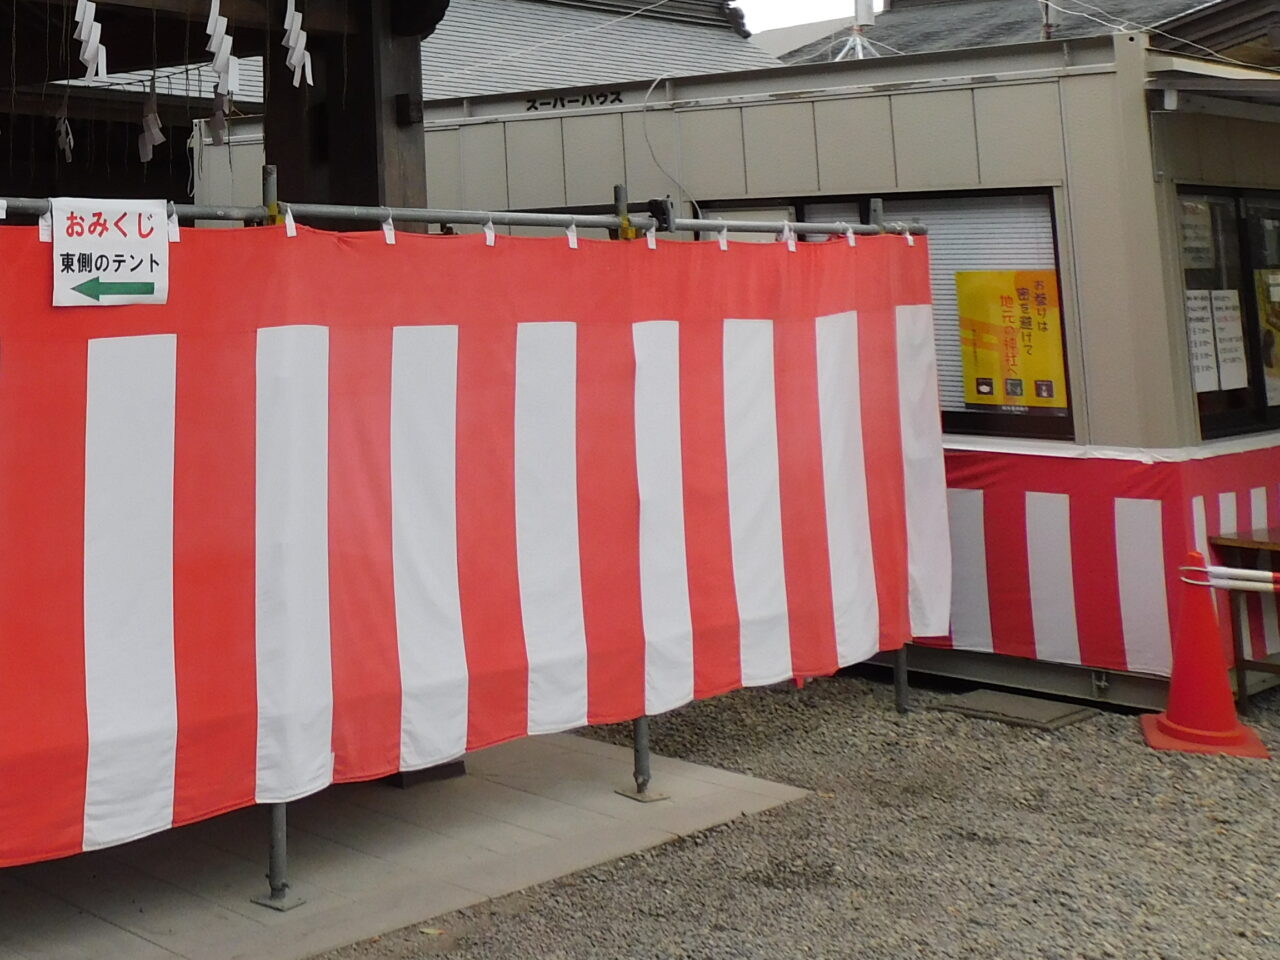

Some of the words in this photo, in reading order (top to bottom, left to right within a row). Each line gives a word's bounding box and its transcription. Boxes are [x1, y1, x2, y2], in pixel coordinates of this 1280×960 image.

[526, 91, 623, 111] スーパーハウス
[65, 211, 155, 239] おみくじ
[60, 252, 161, 274] 東側のテント
[999, 295, 1019, 376] 地元の神社へ
